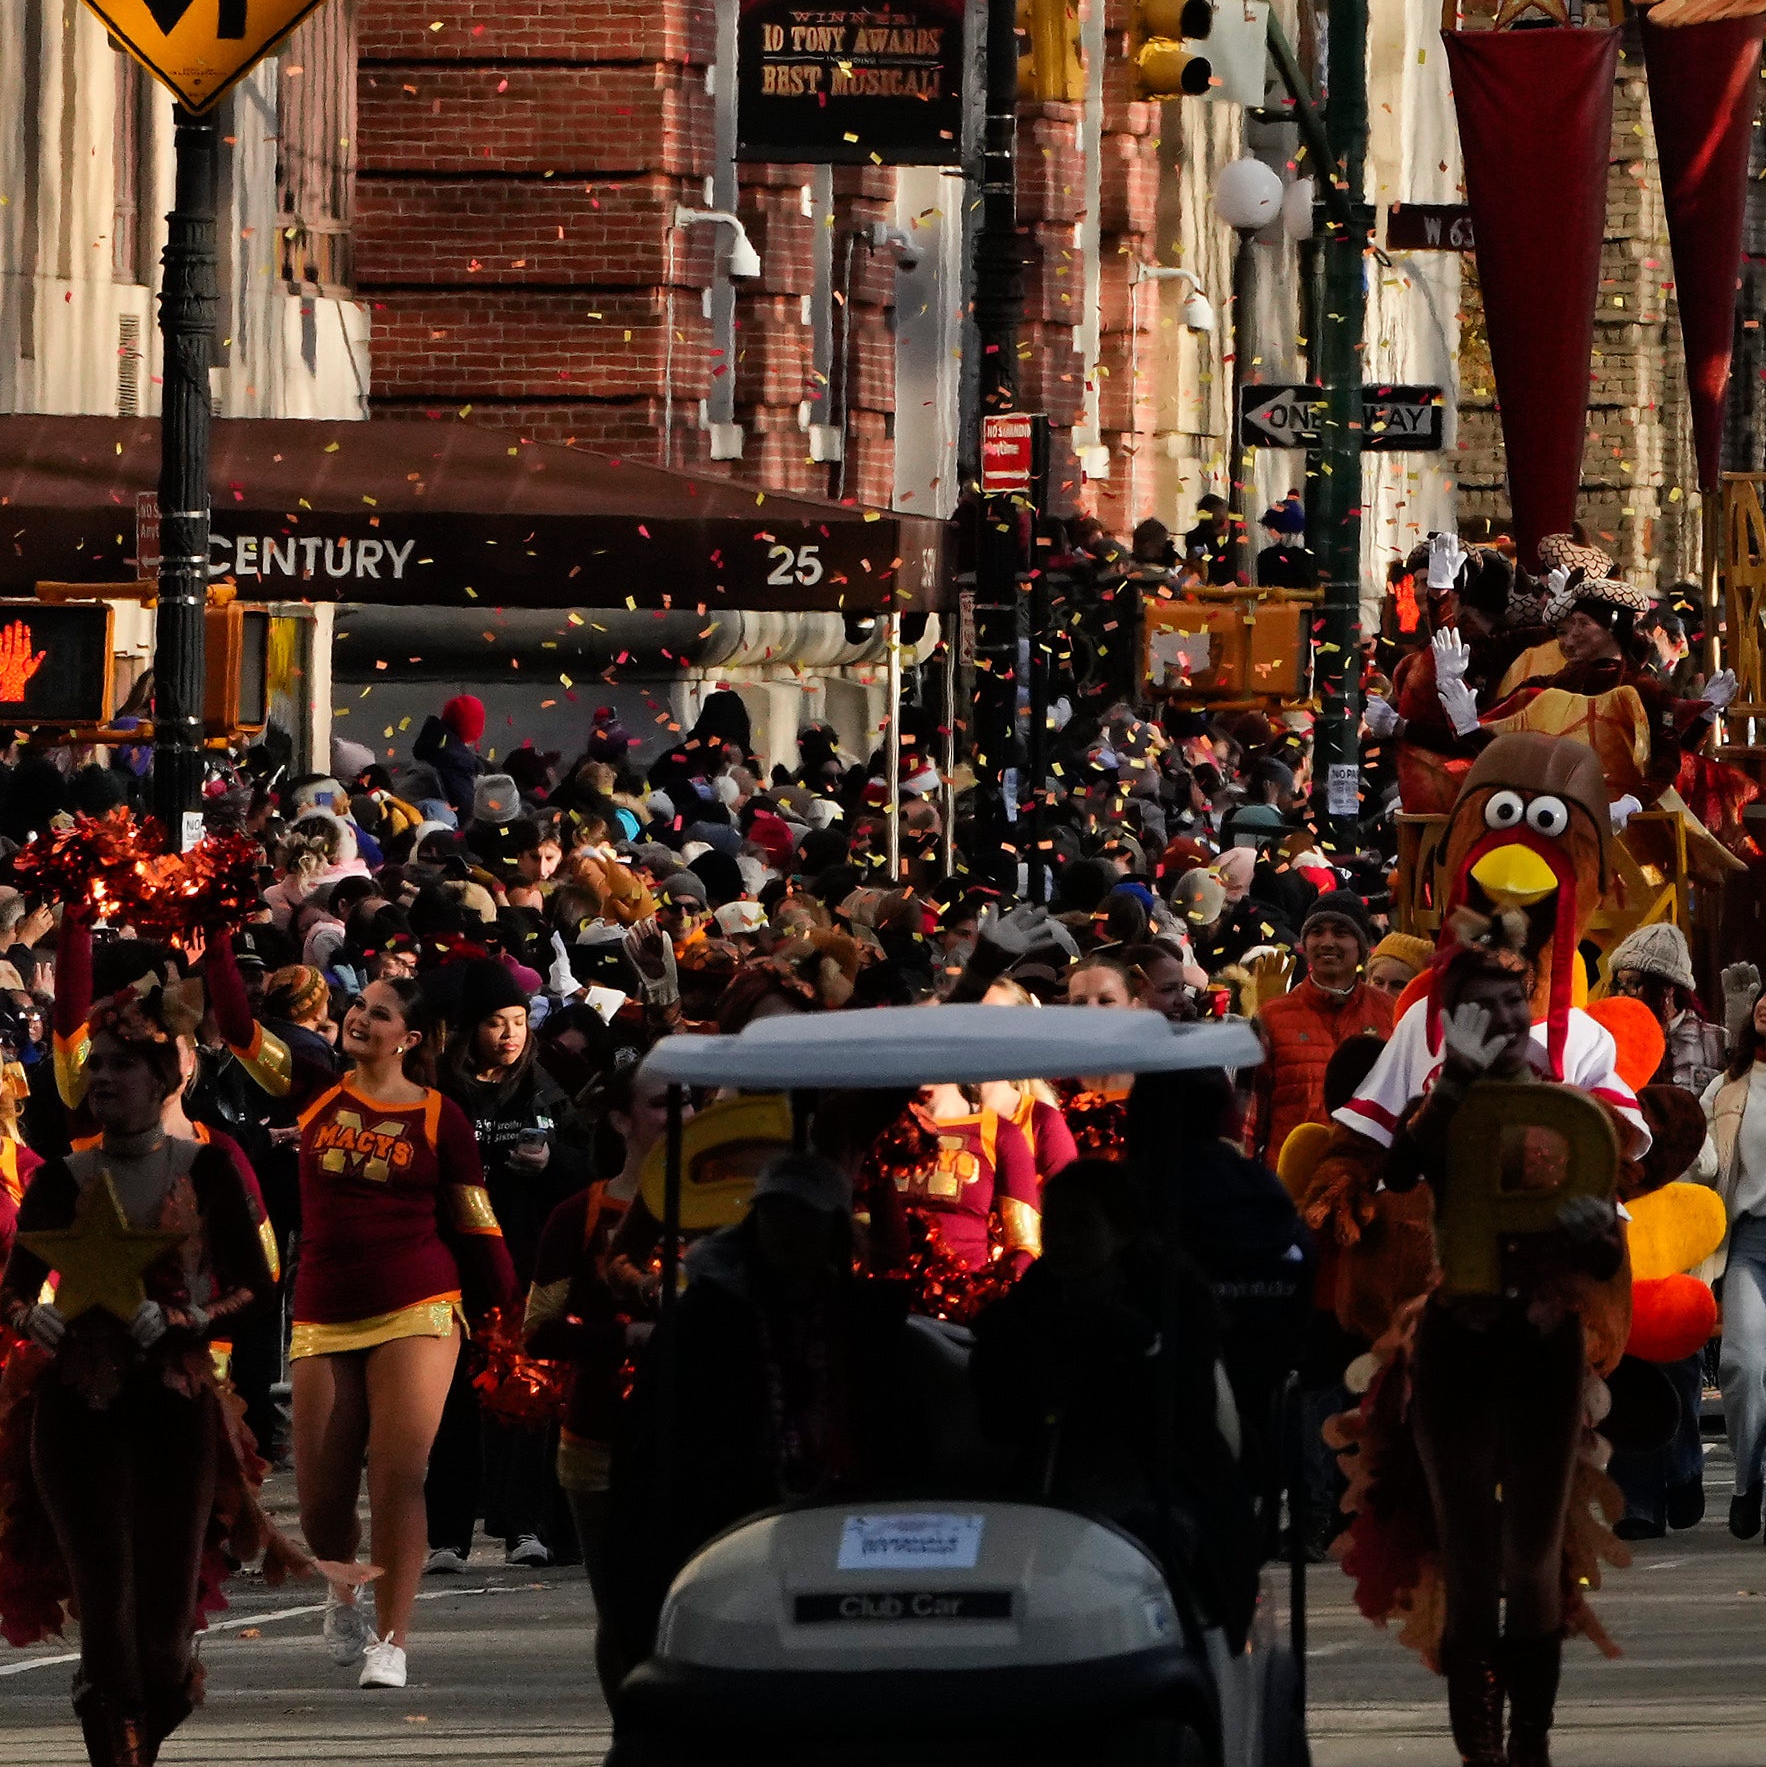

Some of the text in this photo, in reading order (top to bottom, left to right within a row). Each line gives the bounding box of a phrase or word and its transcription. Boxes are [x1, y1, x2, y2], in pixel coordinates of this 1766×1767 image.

[762, 23, 944, 55] 10 TONY AWARDS
[762, 64, 823, 95] BEST
[1424, 216, 1442, 246] W
[987, 425, 997, 438] NO
[1268, 404, 1425, 433] ONE WAY
[207, 534, 415, 579] CENTURY
[767, 545, 823, 586] 25
[186, 819, 200, 831] NO
[313, 1122, 413, 1167] MACYS
[839, 1593, 962, 1618] Club Car
